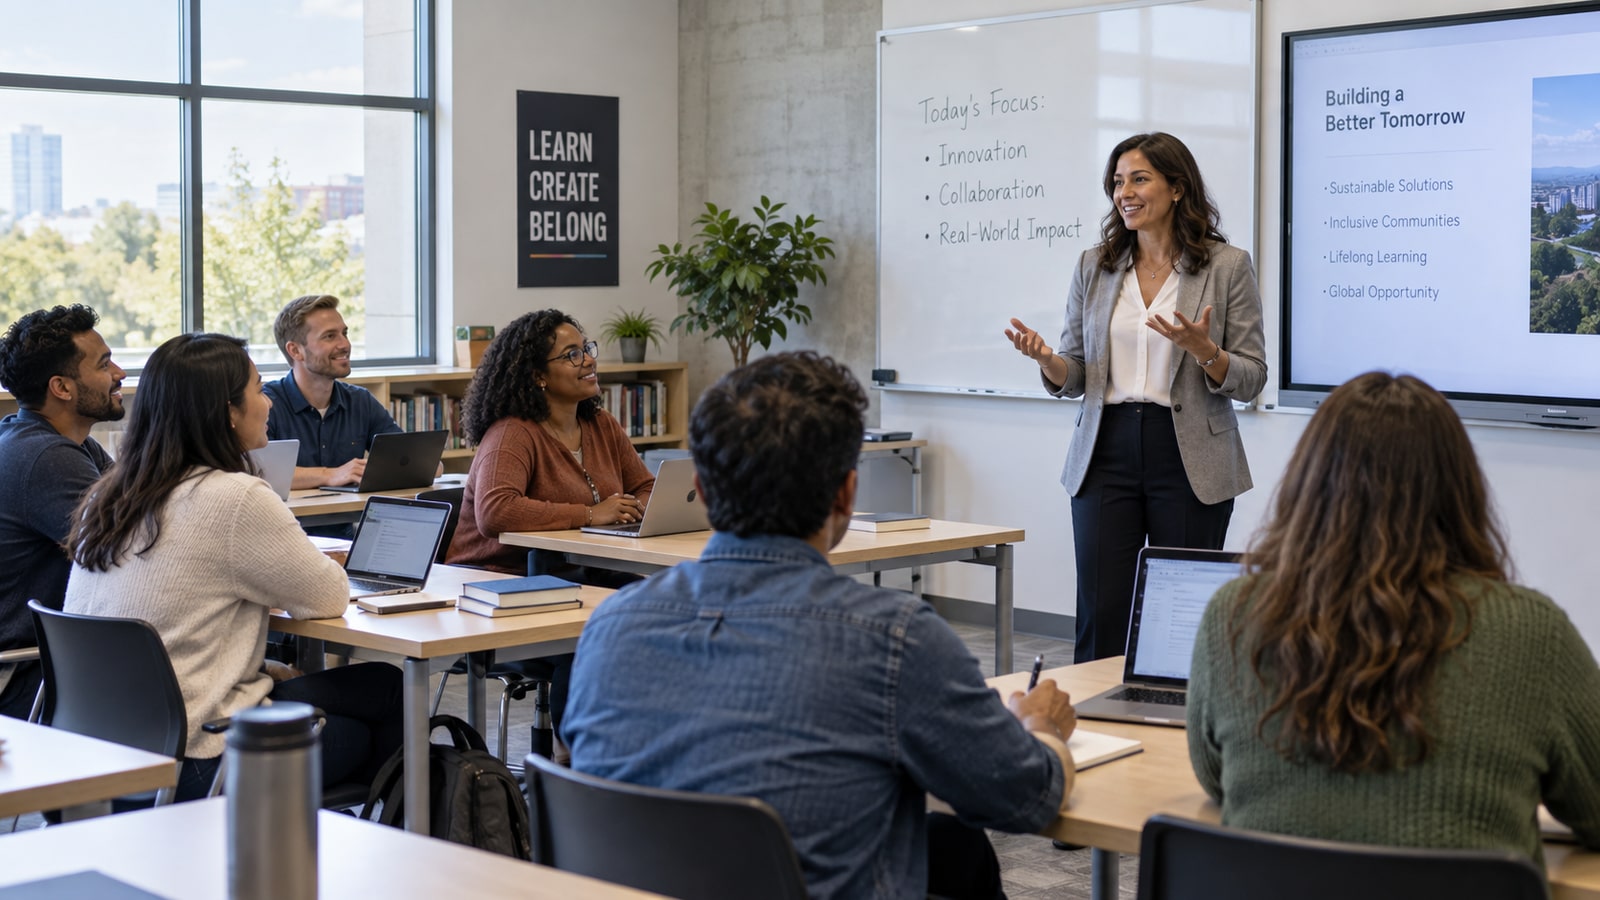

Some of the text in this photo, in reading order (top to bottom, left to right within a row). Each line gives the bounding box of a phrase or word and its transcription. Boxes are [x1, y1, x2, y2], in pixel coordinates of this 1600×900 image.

[918, 87, 1046, 131] Today's Focus:
[1325, 86, 1404, 107] Building a
[1325, 110, 1466, 132] Better Tomorrow
[529, 129, 593, 162] LEARN
[938, 140, 1028, 167] Innovation
[529, 170, 600, 202] CREATE
[939, 178, 1045, 207] Collaboration
[1329, 178, 1454, 195] Sustainable Solutions
[529, 211, 607, 242] BELONG
[939, 217, 1083, 248] Real-World Impact
[1329, 214, 1461, 229] Inclusive Communities
[1329, 249, 1428, 267] Lifelong Learning
[1328, 284, 1440, 302] Global Opportunity
